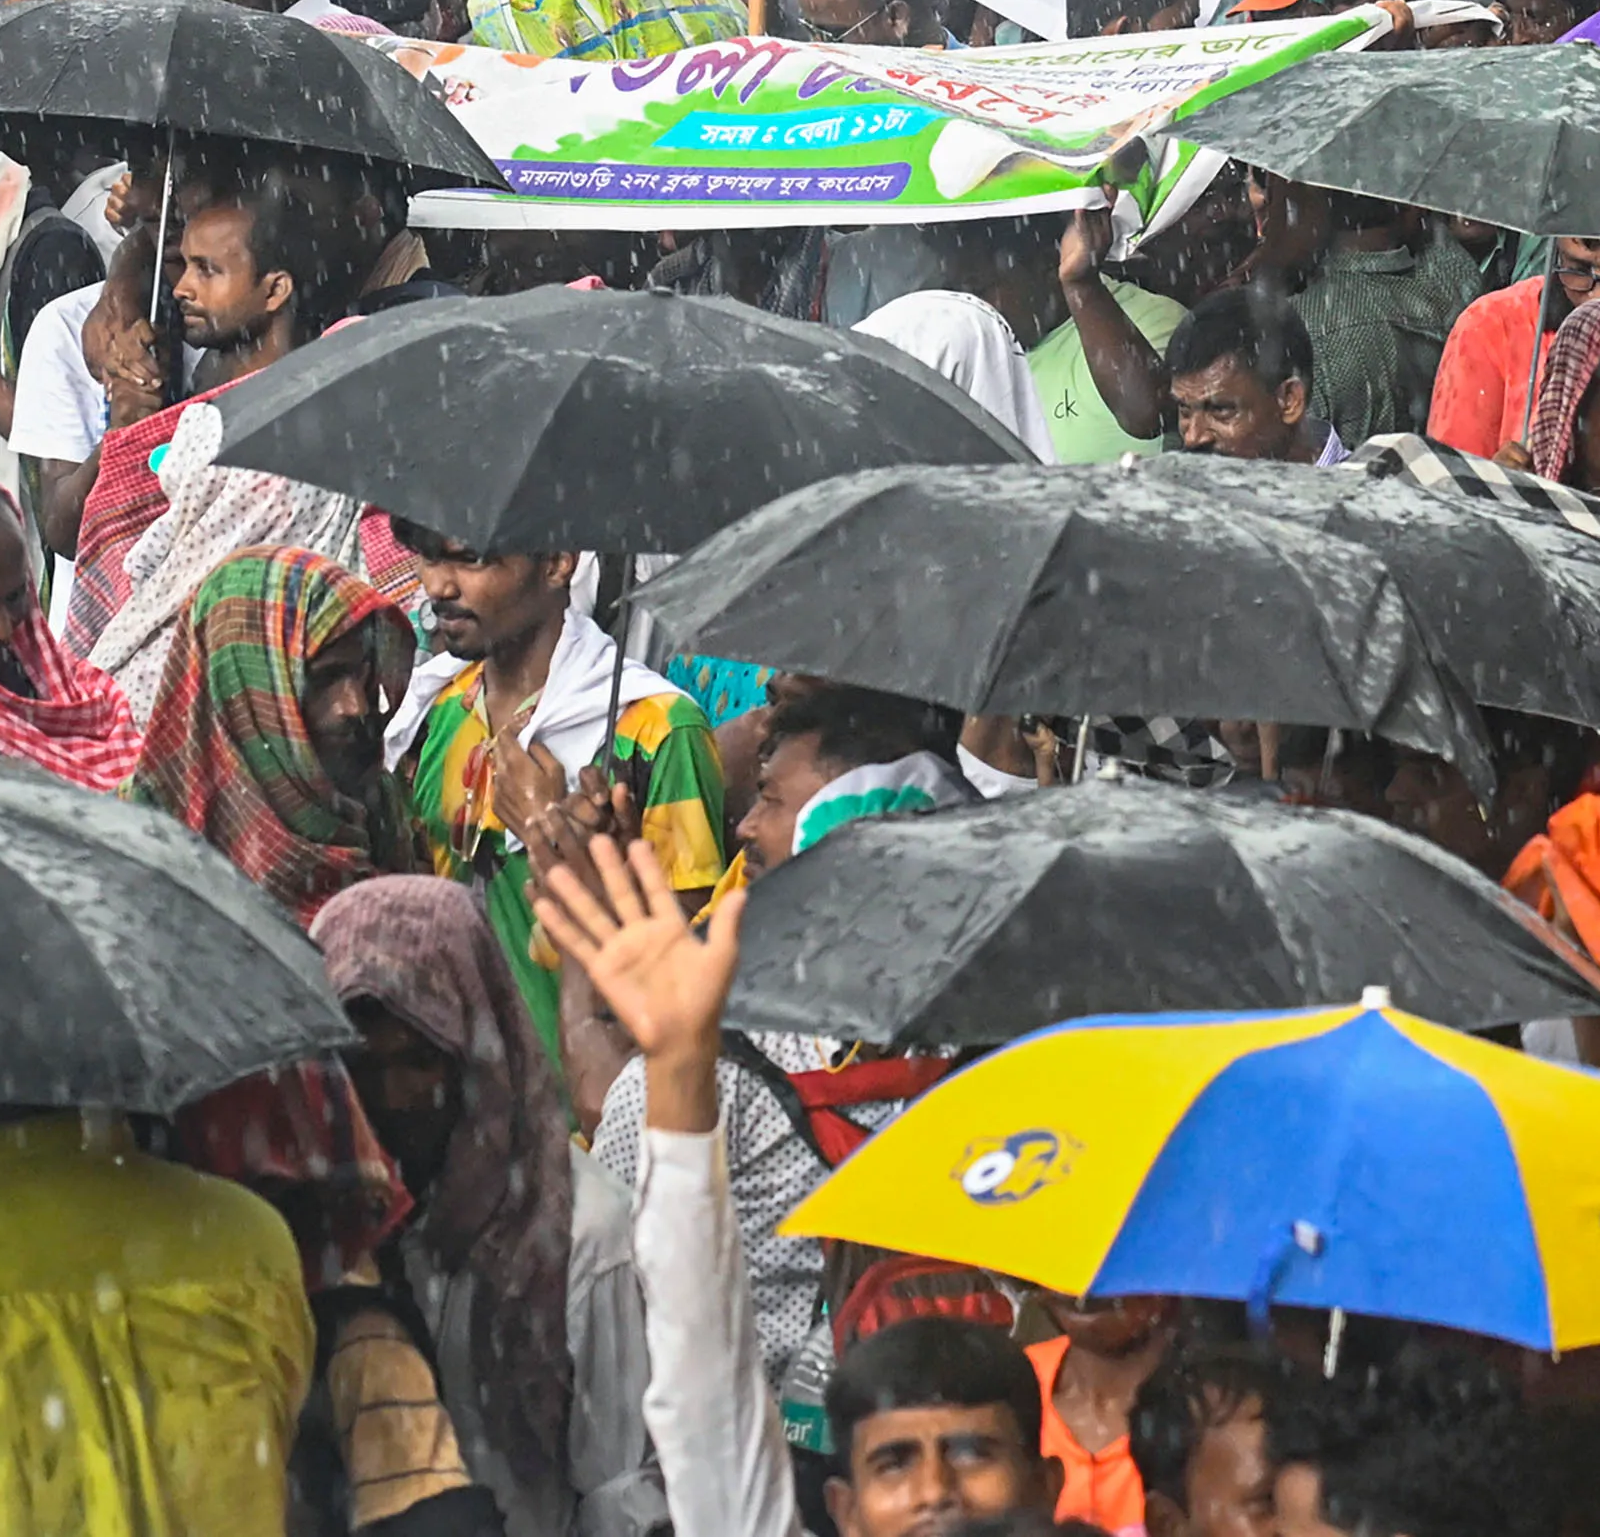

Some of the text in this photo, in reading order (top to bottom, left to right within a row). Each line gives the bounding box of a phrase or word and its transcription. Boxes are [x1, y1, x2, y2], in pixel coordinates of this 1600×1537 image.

[700, 122, 752, 146] সময়
[784, 115, 842, 145] বেলা
[850, 108, 910, 138] ১১টা
[518, 167, 894, 196] ময়নাগুড়ি ২নং ব্লক তৃণমূল যুব কংগ্রেস
[1053, 389, 1079, 419] ck
